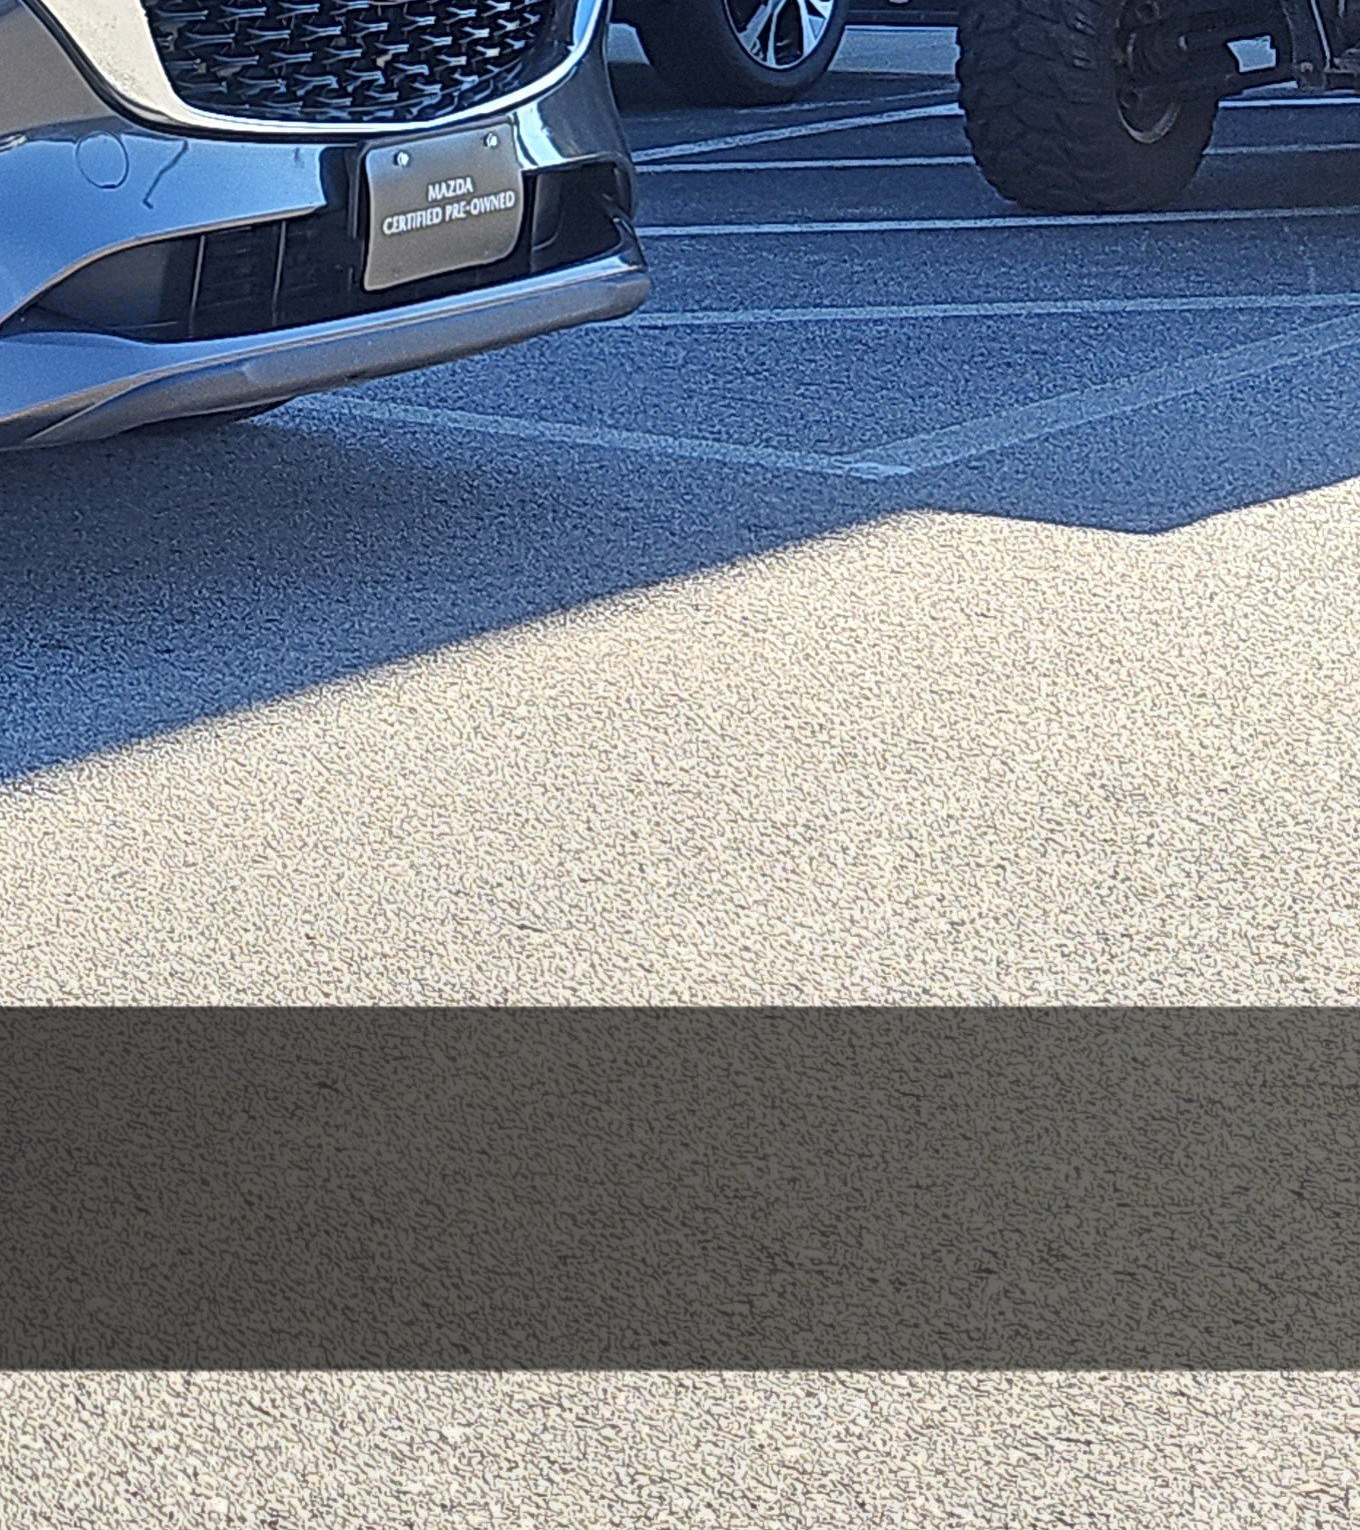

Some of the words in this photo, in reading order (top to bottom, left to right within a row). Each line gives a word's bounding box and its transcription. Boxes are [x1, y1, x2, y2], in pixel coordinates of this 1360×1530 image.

[427, 176, 474, 201] MAZDA
[382, 206, 442, 235] CERTIFIED
[444, 190, 516, 222] PRE-OWNED
